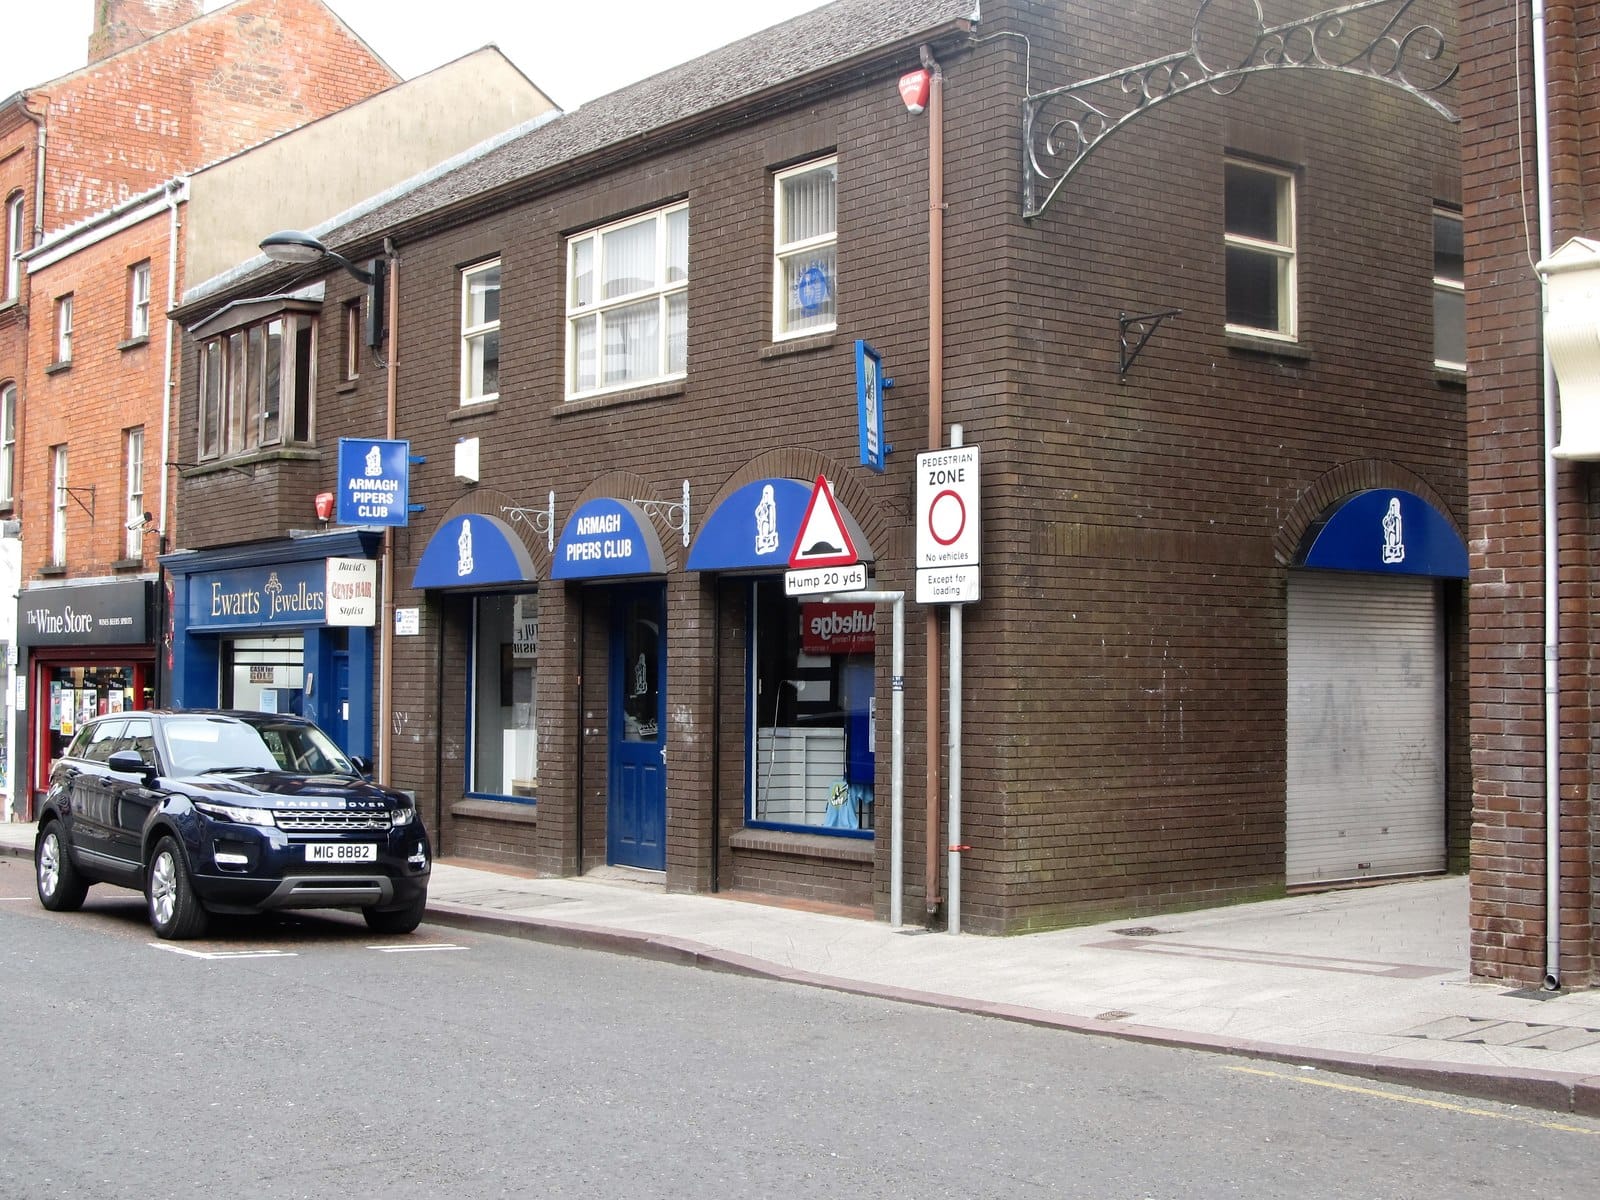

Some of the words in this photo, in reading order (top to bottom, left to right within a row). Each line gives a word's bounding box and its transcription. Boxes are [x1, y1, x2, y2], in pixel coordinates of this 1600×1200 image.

[922, 453, 973, 468] PEDESTRIAN
[929, 468, 966, 486] ZONE
[348, 478, 399, 491] ARMAGH
[353, 492, 394, 504] PIPERS
[358, 505, 388, 518] CLUB
[576, 513, 621, 536] ARMAGH
[566, 541, 602, 561] PIPERS
[604, 538, 632, 559] CLUB
[926, 553, 937, 562] No
[938, 551, 969, 561] vehicles
[338, 562, 367, 572] David's
[788, 576, 820, 589] Hump
[823, 572, 839, 585] 20
[842, 571, 862, 586] yds
[927, 575, 953, 585] Except
[955, 573, 967, 583] for
[933, 586, 961, 596] loading
[211, 582, 260, 616] Ewarts
[266, 581, 324, 619] Jewellers
[339, 606, 364, 617] Stylist
[27, 609, 37, 625] The
[36, 608, 63, 634] Wine
[64, 605, 93, 633] Store
[275, 800, 329, 808] RANGE
[313, 846, 334, 858] MIG
[337, 846, 370, 858] 8882
